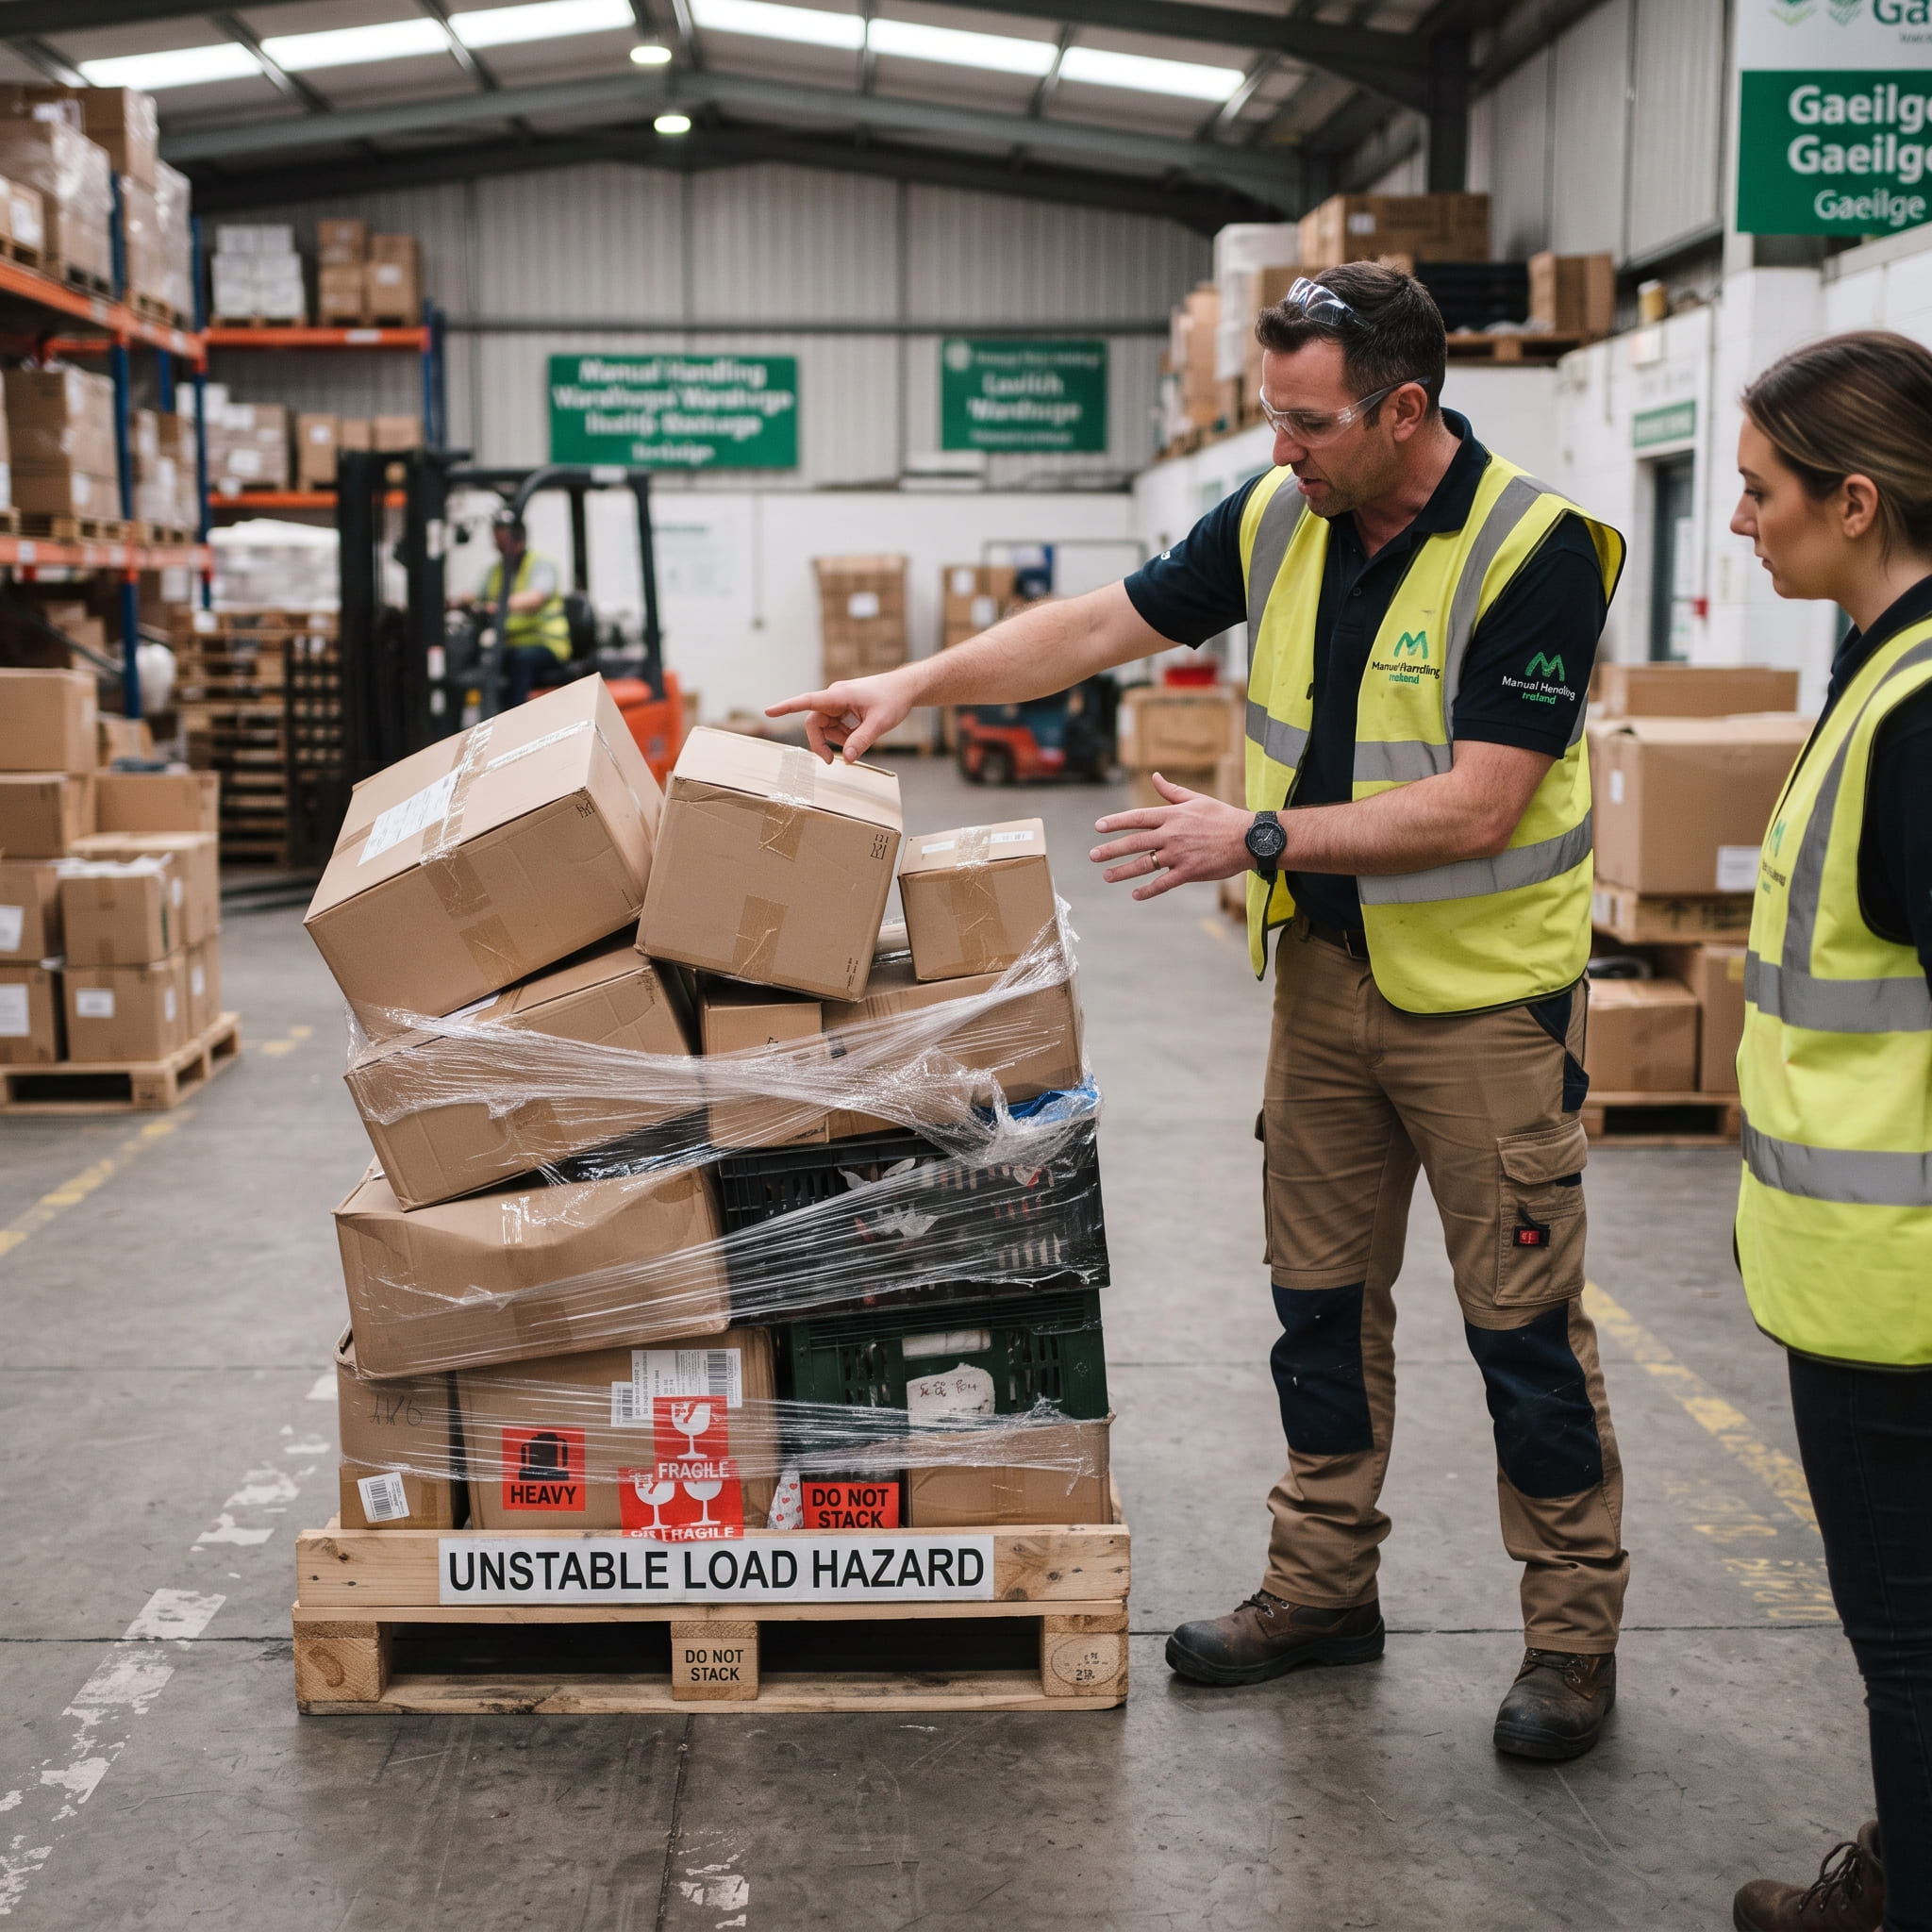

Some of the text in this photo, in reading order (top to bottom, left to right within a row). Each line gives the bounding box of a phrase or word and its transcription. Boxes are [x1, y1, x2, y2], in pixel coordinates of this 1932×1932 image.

[1789, 84, 1932, 134] Gaeilg
[1787, 134, 1932, 184] Gaeilg
[1814, 189, 1926, 226] Gaeilge
[1502, 675, 1539, 691] Manual
[658, 1460, 730, 1479] FRAGILE
[510, 1485, 576, 1505] HEAVY
[812, 1489, 890, 1507] DO NOT
[818, 1510, 883, 1528] STACK
[448, 1548, 985, 1591] UNSTABLE LOAD HAZARD
[685, 1649, 743, 1663] DO NOT
[691, 1667, 740, 1682] STACK
